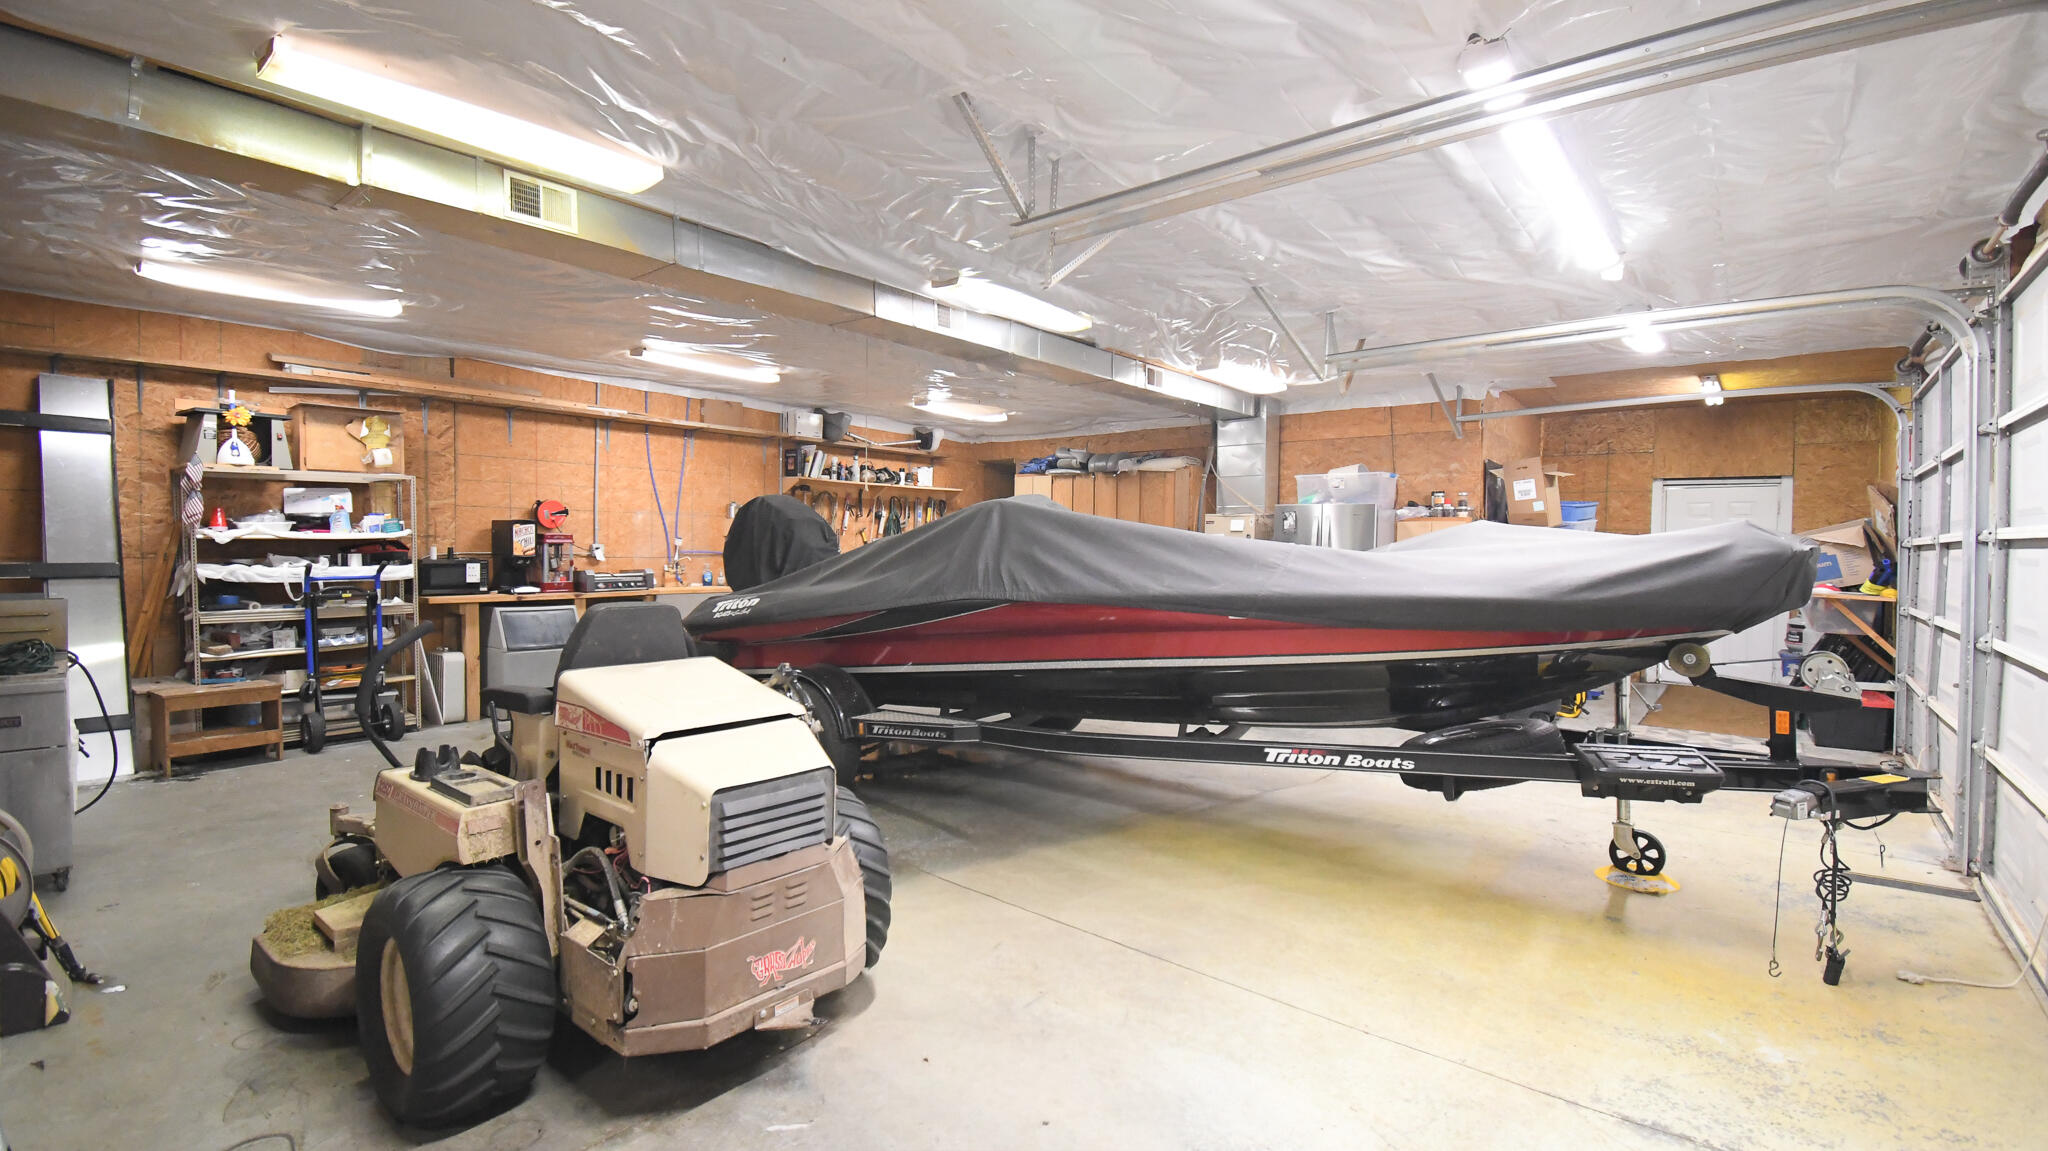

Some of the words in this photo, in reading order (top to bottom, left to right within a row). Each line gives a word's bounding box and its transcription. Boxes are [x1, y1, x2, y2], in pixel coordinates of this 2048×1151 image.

[712, 597, 761, 613] Triton
[1264, 747, 1341, 766] Triton
[1343, 754, 1416, 770] Boats
